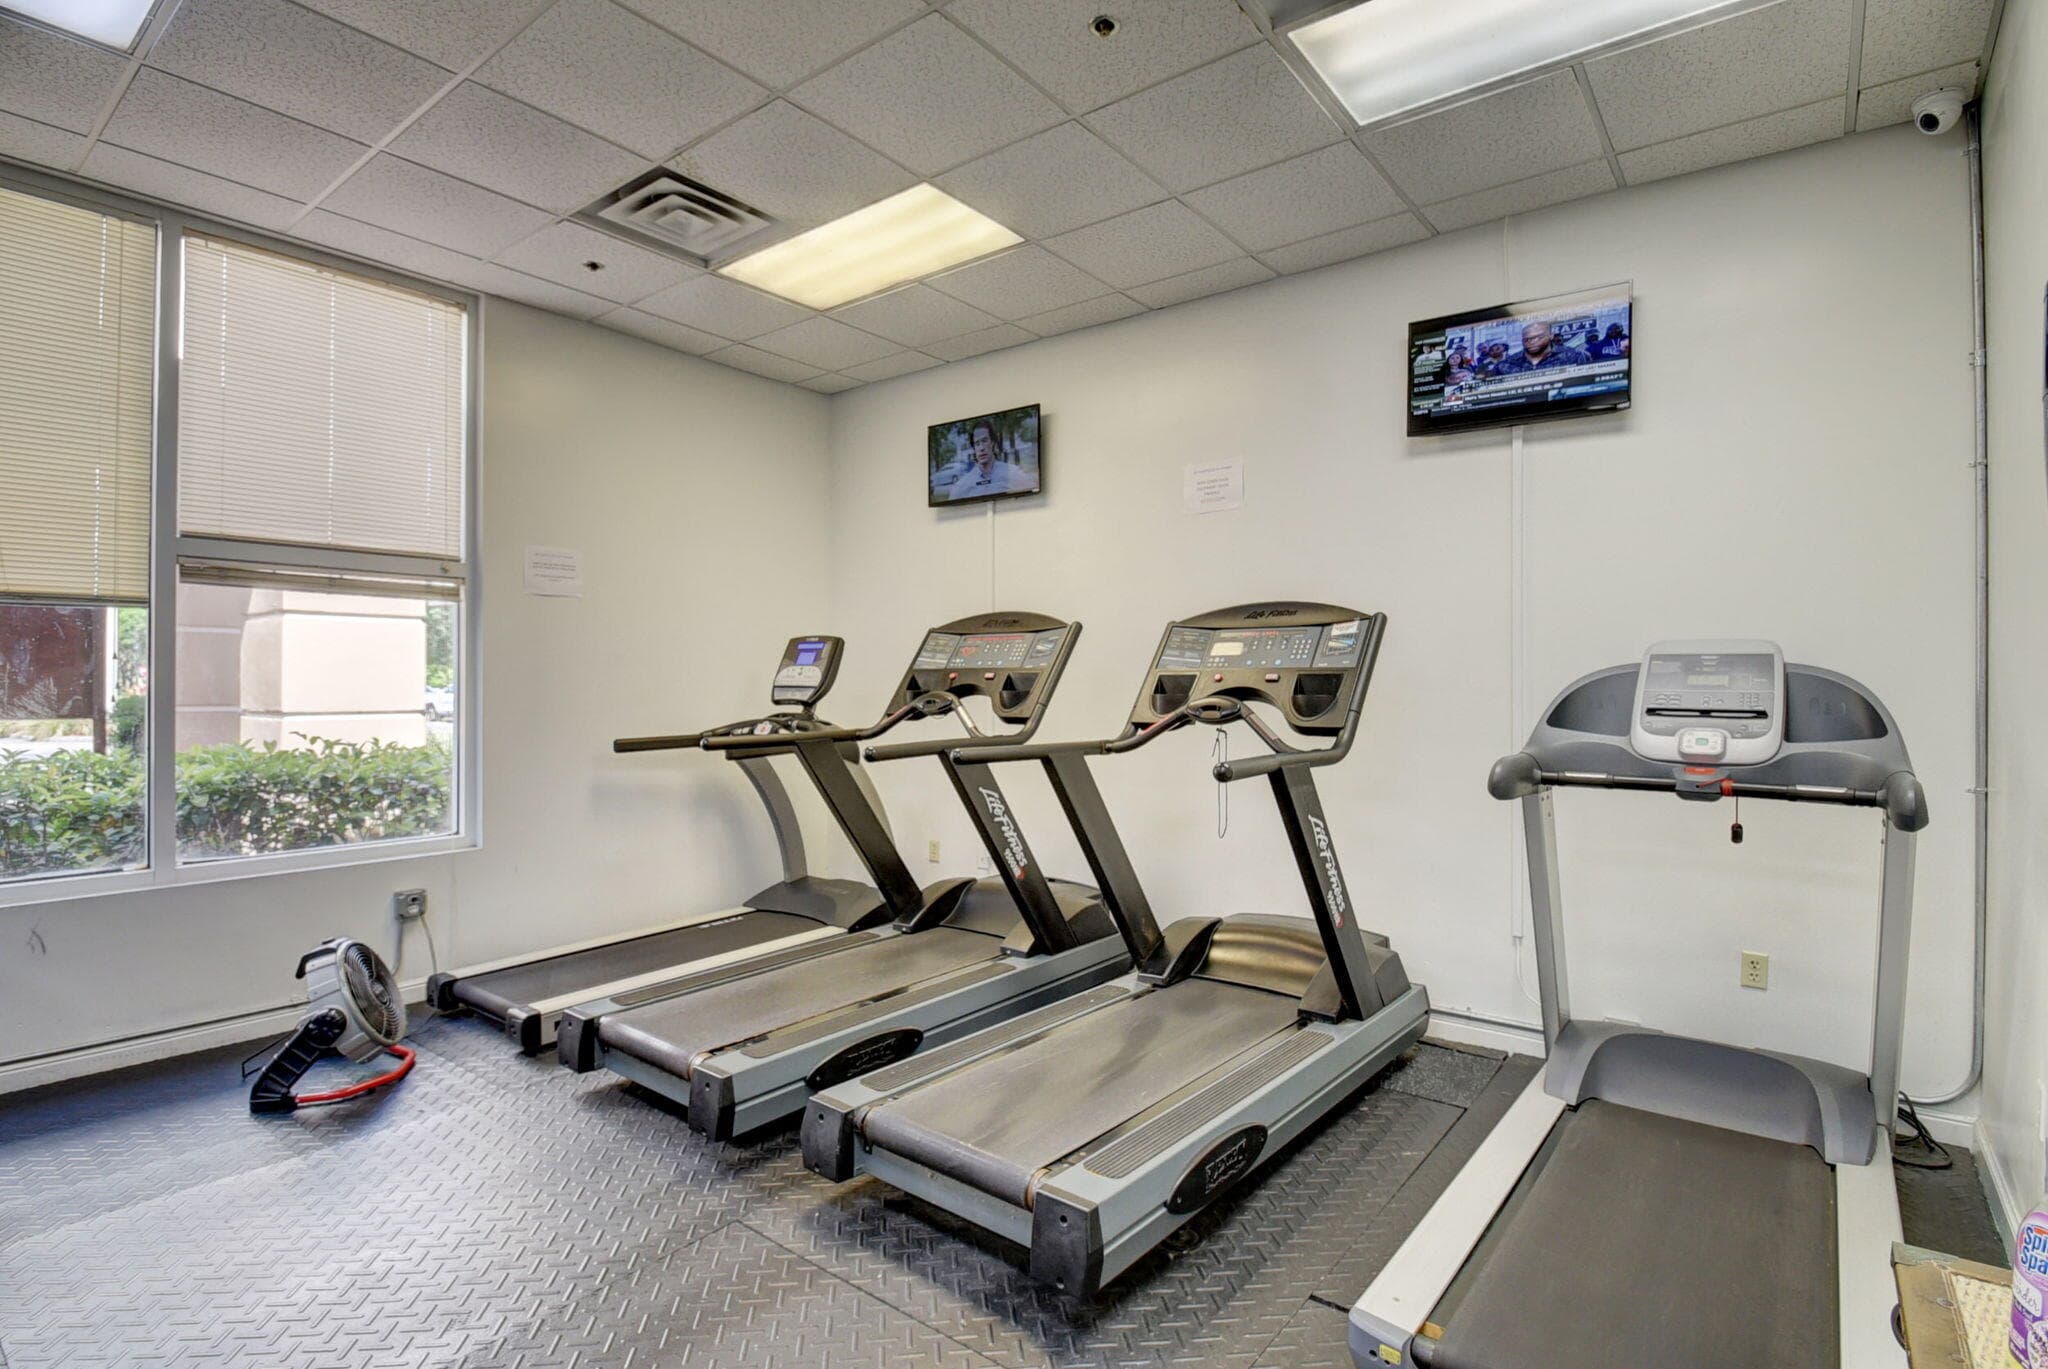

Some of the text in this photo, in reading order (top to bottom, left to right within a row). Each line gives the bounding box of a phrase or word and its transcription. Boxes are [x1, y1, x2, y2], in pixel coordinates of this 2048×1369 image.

[1551, 320, 1593, 333] RAFT
[979, 787, 1028, 867] Life Fitness
[1308, 814, 1346, 913] Life Fitness
[2024, 1226, 2048, 1253] Spi
[2021, 1246, 2048, 1275] Spa
